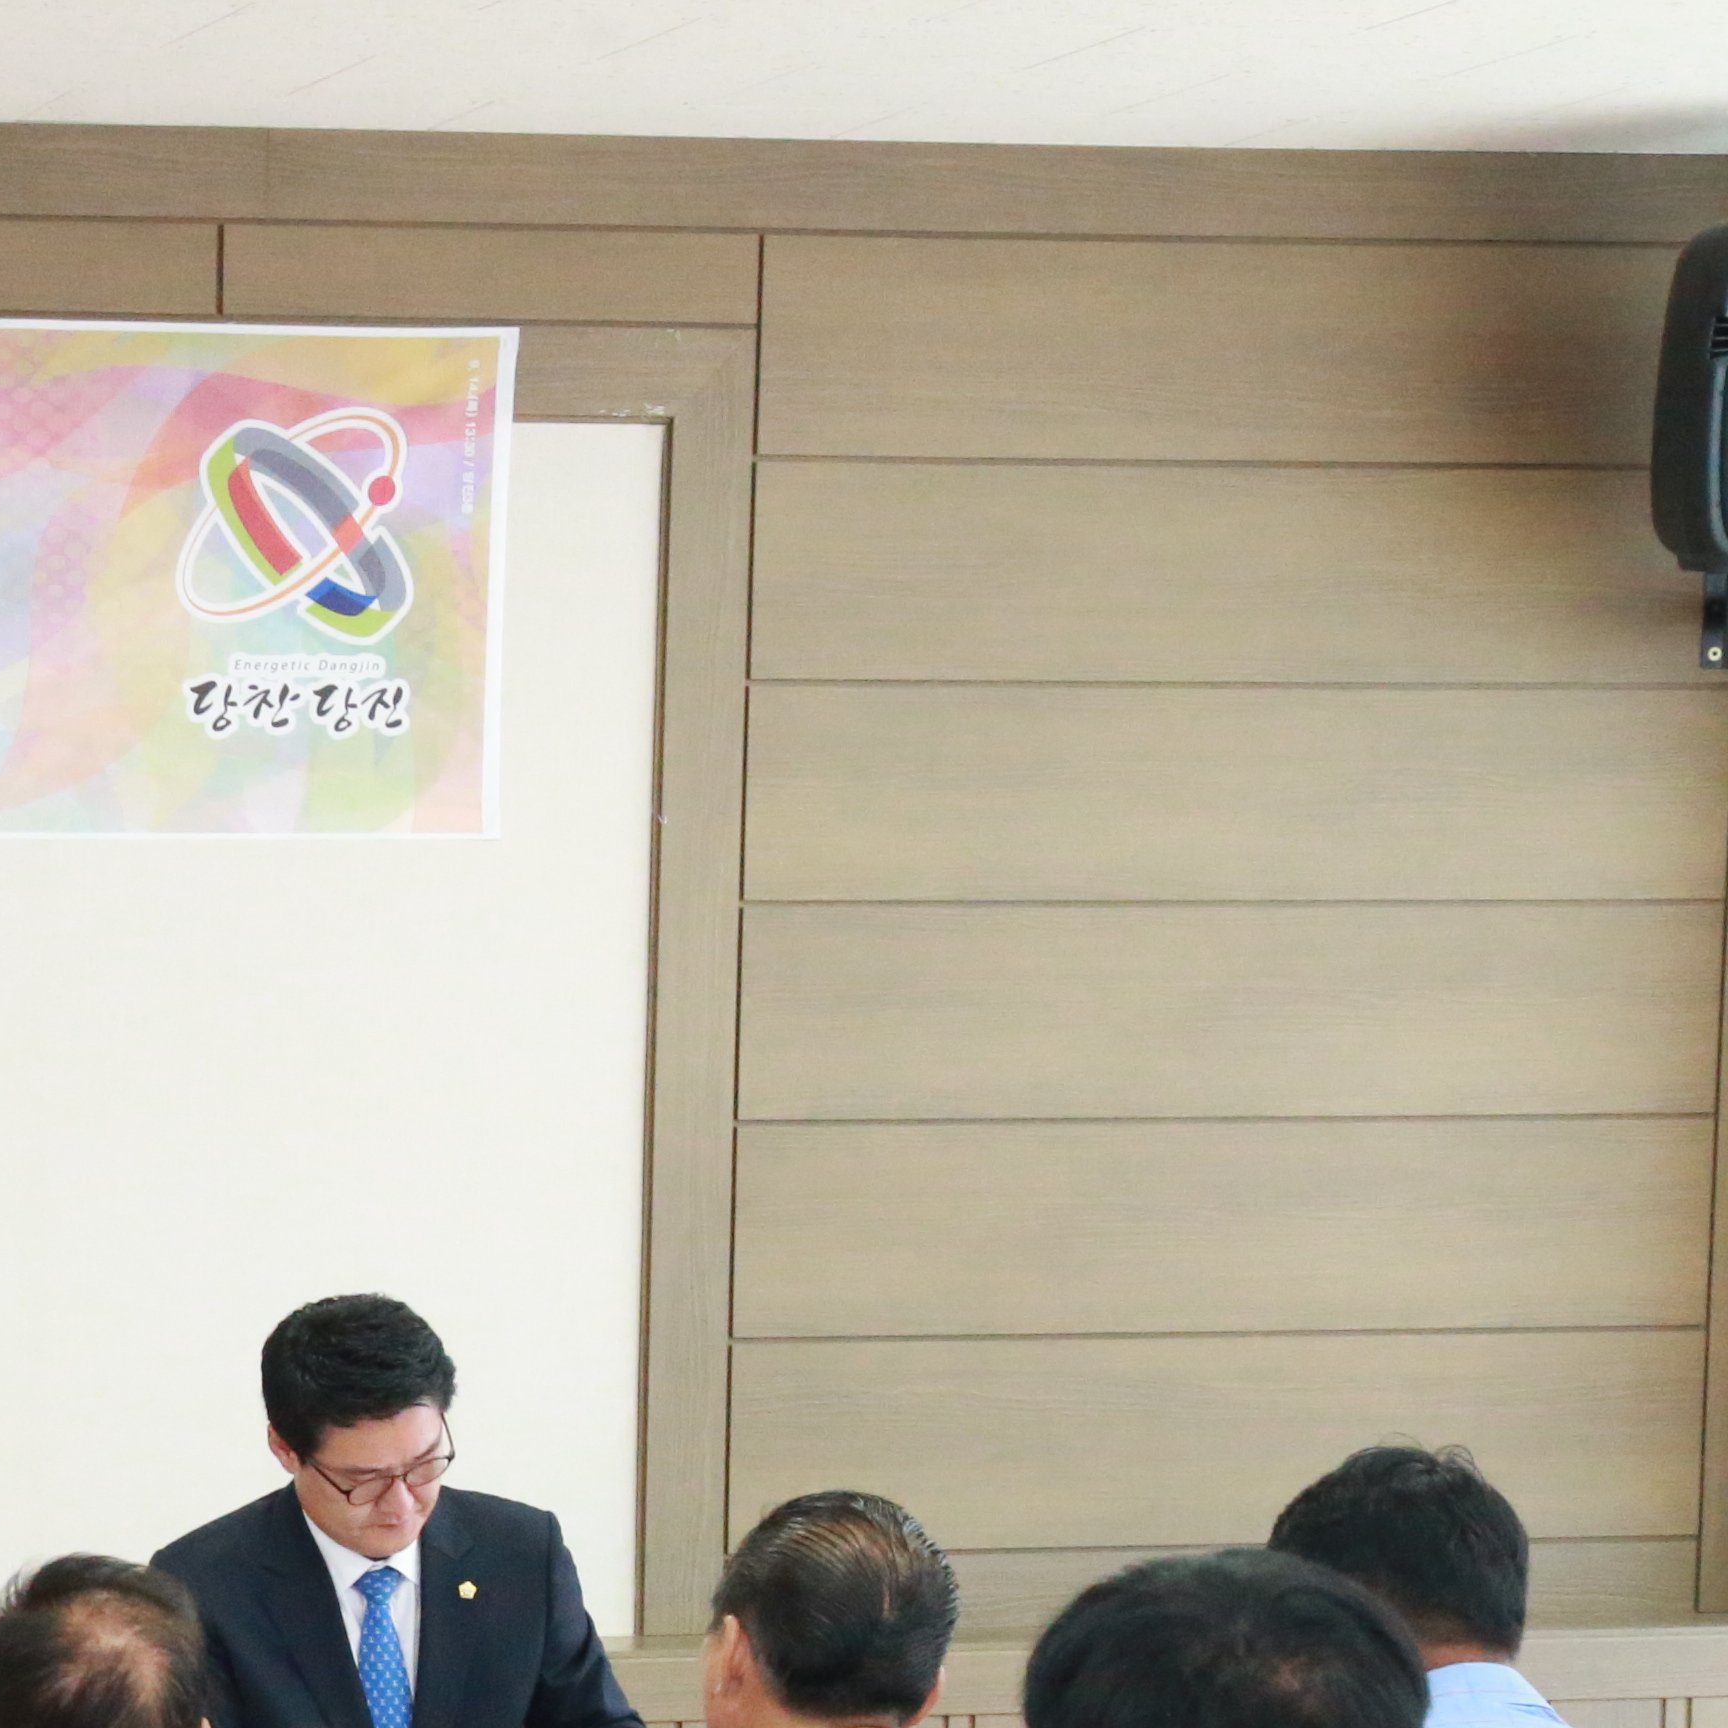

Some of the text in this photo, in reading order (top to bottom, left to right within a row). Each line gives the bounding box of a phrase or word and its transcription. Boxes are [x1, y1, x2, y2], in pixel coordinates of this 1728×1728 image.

[234, 659, 380, 674] Energetic Dangjin
[312, 684, 404, 733] 당진
